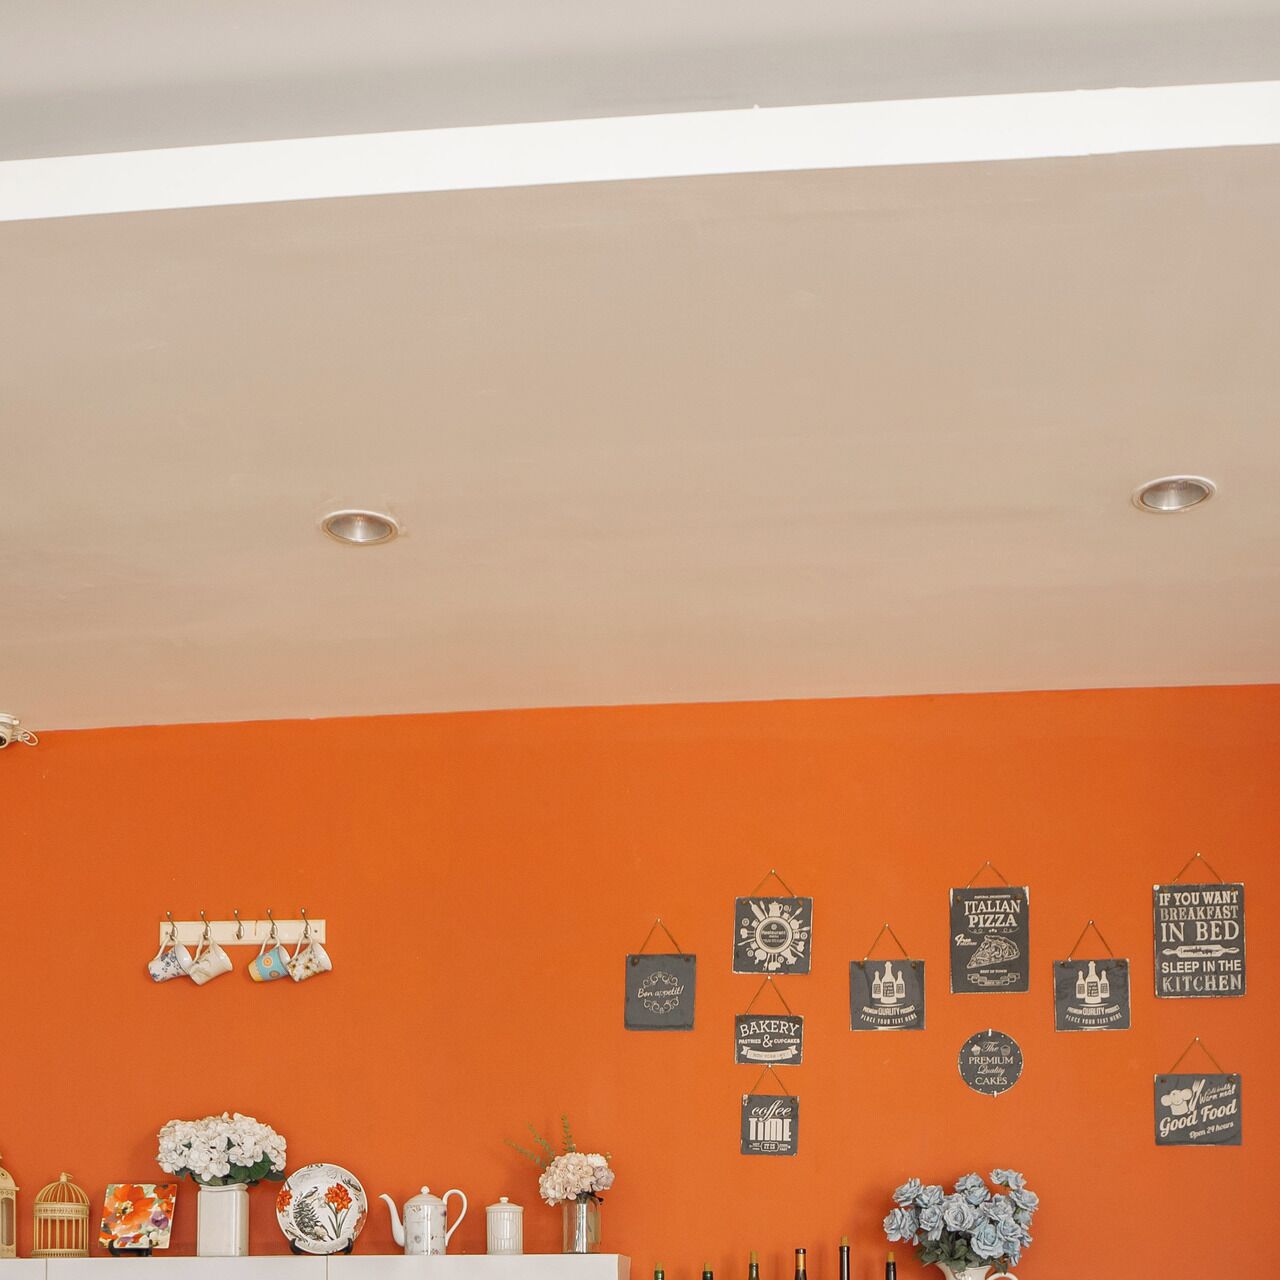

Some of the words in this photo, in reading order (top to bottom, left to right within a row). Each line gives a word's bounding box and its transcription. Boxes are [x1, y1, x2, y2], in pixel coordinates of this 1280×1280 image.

[1159, 893, 1171, 906] IF
[1173, 892, 1200, 906] YOU
[1202, 891, 1239, 905] WANT
[964, 900, 1021, 916] ITALIAN
[1160, 905, 1239, 921] BREAKFAST
[968, 914, 1018, 928] PIZZA
[1160, 922, 1185, 942] IN
[1195, 920, 1240, 941] BED
[1161, 961, 1200, 974] SLEEP
[1202, 960, 1216, 972] IN
[1218, 959, 1242, 972] THE
[1162, 974, 1242, 993] KITCHEN
[637, 987, 653, 999] Bon
[860, 1014, 876, 1024] PLACE
[892, 1017, 904, 1025] TEXT
[904, 1012, 918, 1022] HERE
[878, 1007, 900, 1016] QUALITY
[1082, 1007, 1105, 1016] QUALITY
[1065, 1014, 1080, 1024] PLACE
[739, 1020, 800, 1037] BAKERY
[762, 1034, 773, 1048] &
[982, 1041, 1000, 1052] The
[968, 1056, 1014, 1065] PREMIUM
[977, 1064, 1006, 1077] Quality
[975, 1076, 1008, 1085] CAKES
[1199, 1093, 1218, 1104] Warm
[751, 1100, 792, 1122] coffee
[1160, 1110, 1198, 1138] Good
[1200, 1098, 1238, 1123] Food
[1189, 1129, 1206, 1140] Open
[1215, 1121, 1234, 1132] hours
